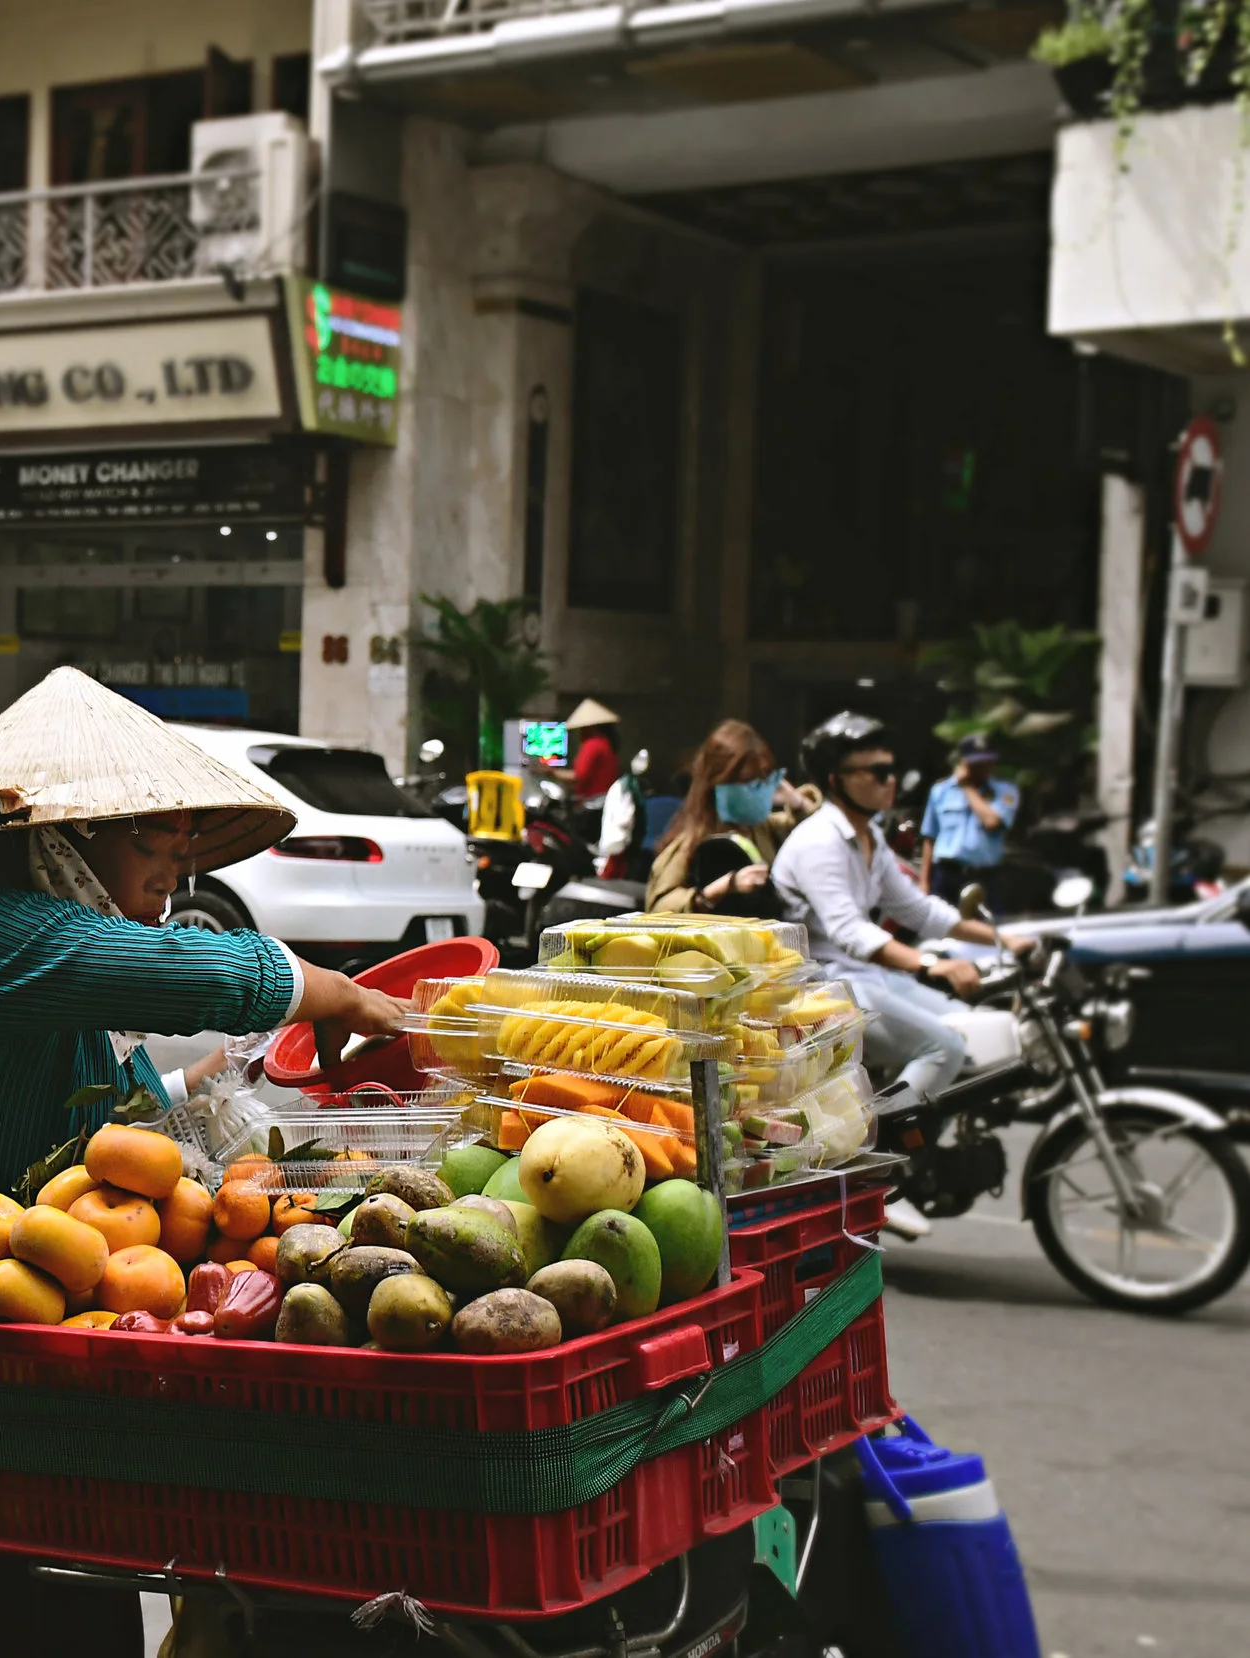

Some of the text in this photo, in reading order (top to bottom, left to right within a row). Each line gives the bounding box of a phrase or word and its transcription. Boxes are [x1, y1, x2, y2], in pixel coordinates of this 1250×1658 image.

[162, 355, 254, 397] LTD
[18, 464, 90, 486] MONEY
[95, 457, 200, 483] CHANGER
[687, 1632, 721, 1658] HONDA
